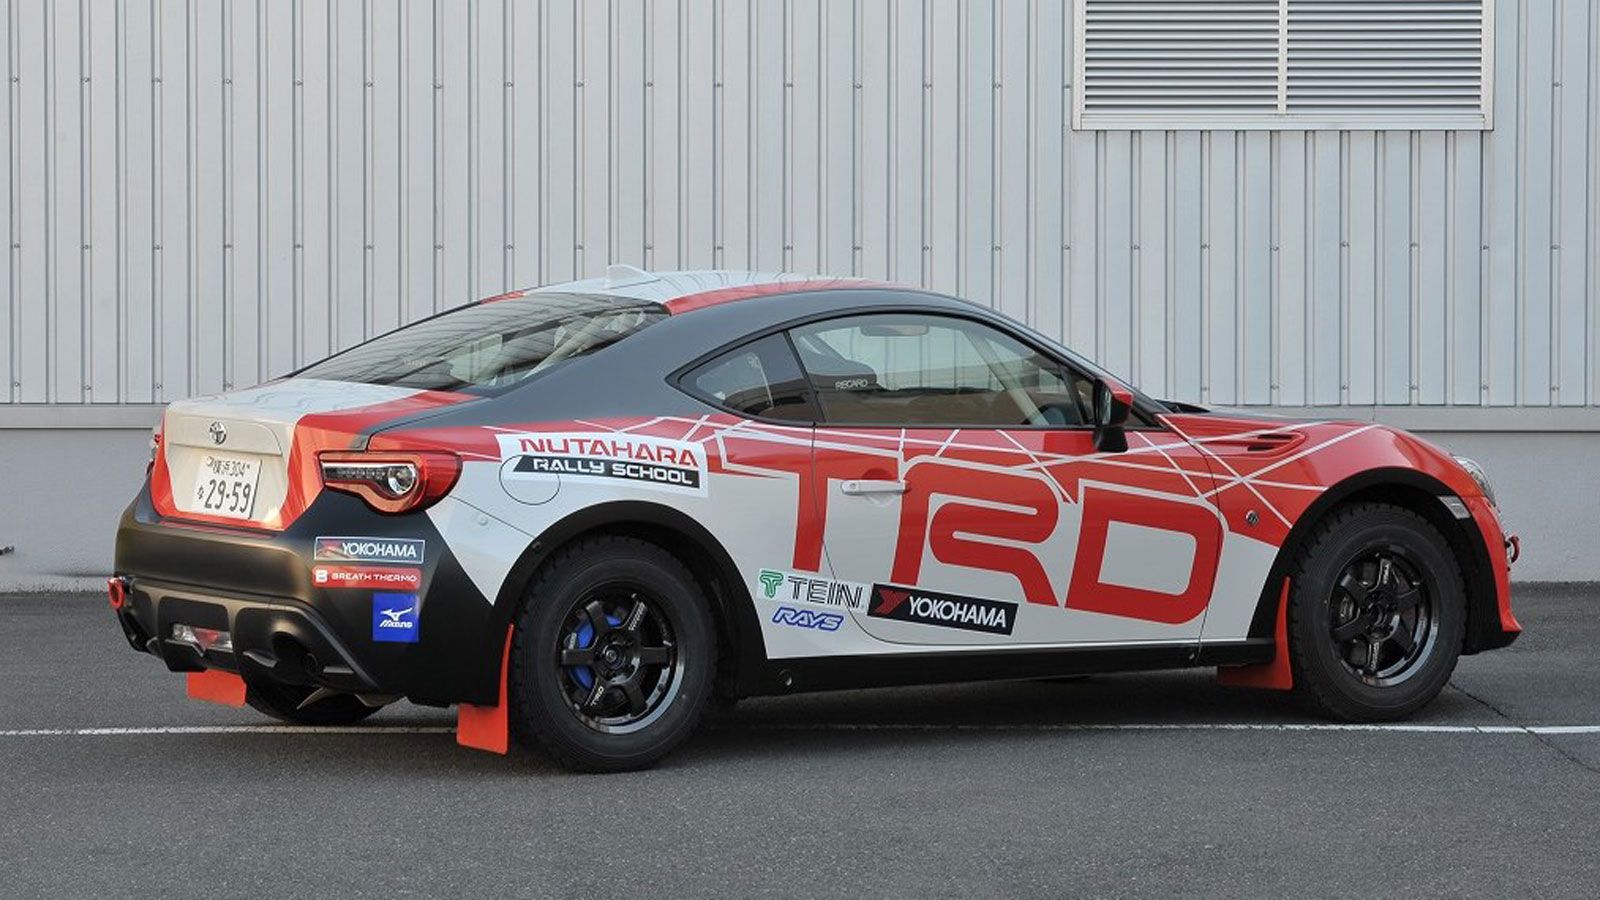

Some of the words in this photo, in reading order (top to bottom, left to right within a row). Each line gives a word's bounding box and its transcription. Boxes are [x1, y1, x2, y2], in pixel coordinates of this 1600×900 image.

[835, 379, 868, 391] RECARO
[518, 438, 699, 467] NUTAHARA
[533, 458, 605, 473] RALLY
[612, 464, 693, 485] SCHOOL
[721, 431, 1223, 625] TRD
[342, 542, 417, 558] YOKOHAMA
[331, 572, 372, 581] BREATH
[373, 574, 417, 583] THERMO
[788, 576, 863, 609] TEIN
[772, 606, 844, 631] RAYS
[909, 596, 1007, 628] YOKOHAMA
